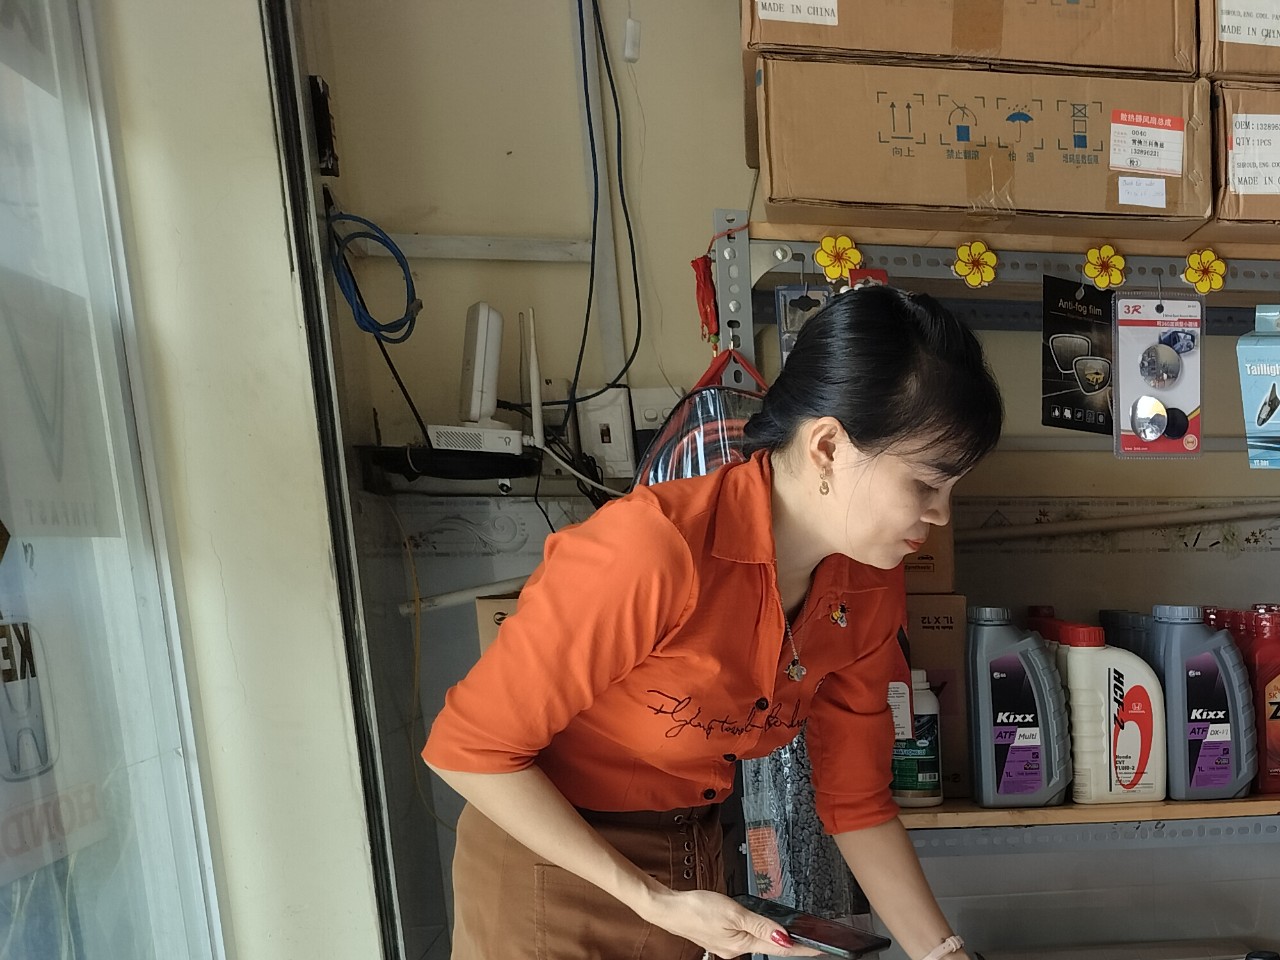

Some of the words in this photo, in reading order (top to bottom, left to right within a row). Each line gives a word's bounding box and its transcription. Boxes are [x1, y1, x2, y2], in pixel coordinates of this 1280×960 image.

[760, 1, 785, 13] MADE
[791, 4, 802, 14] IN
[807, 5, 836, 18] CHINA
[1221, 24, 1242, 35] MADE
[1247, 26, 1257, 37] IN
[892, 147, 915, 158] 向上
[1237, 176, 1259, 185] MADE
[1264, 176, 1274, 185] IN
[1058, 298, 1088, 315] Anti-fog
[1088, 304, 1102, 315] film
[1113, 668, 1125, 731] HCF-2
[996, 711, 1035, 723] Kixx
[1190, 708, 1226, 720] Kixx
[995, 730, 1016, 740] ATF
[1017, 732, 1037, 741] Multi
[1189, 727, 1209, 736] ATF
